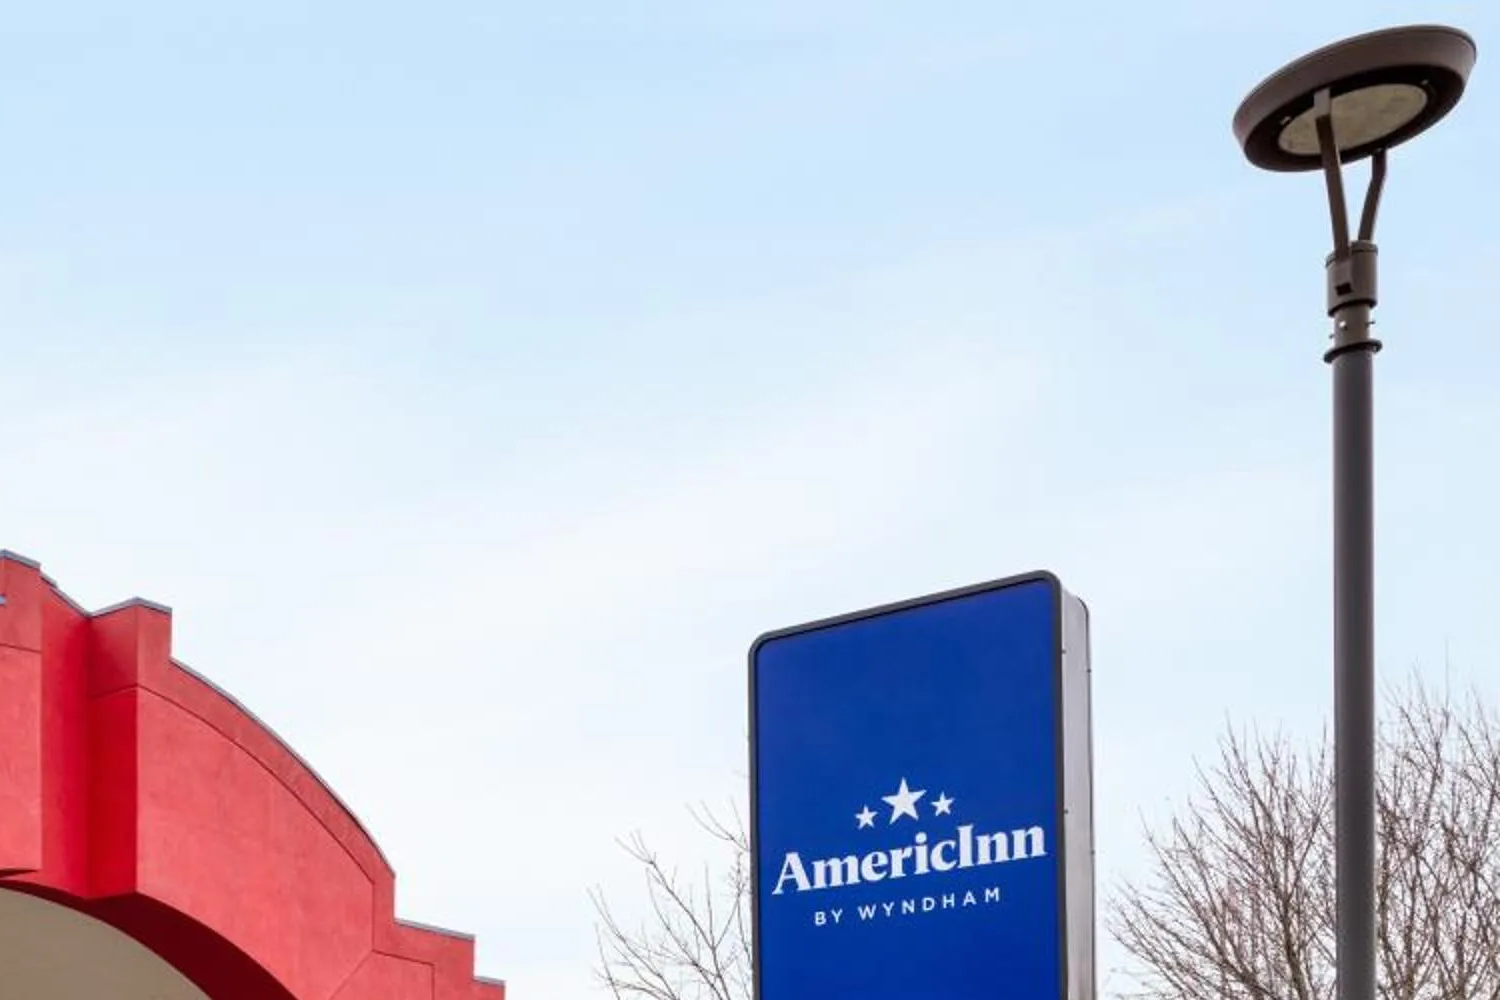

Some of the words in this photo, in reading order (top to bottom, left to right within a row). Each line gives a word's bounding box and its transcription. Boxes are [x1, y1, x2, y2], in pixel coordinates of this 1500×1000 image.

[772, 824, 1047, 895] AmericInn
[814, 909, 844, 926] BY
[858, 887, 1001, 920] WYNDHAM
